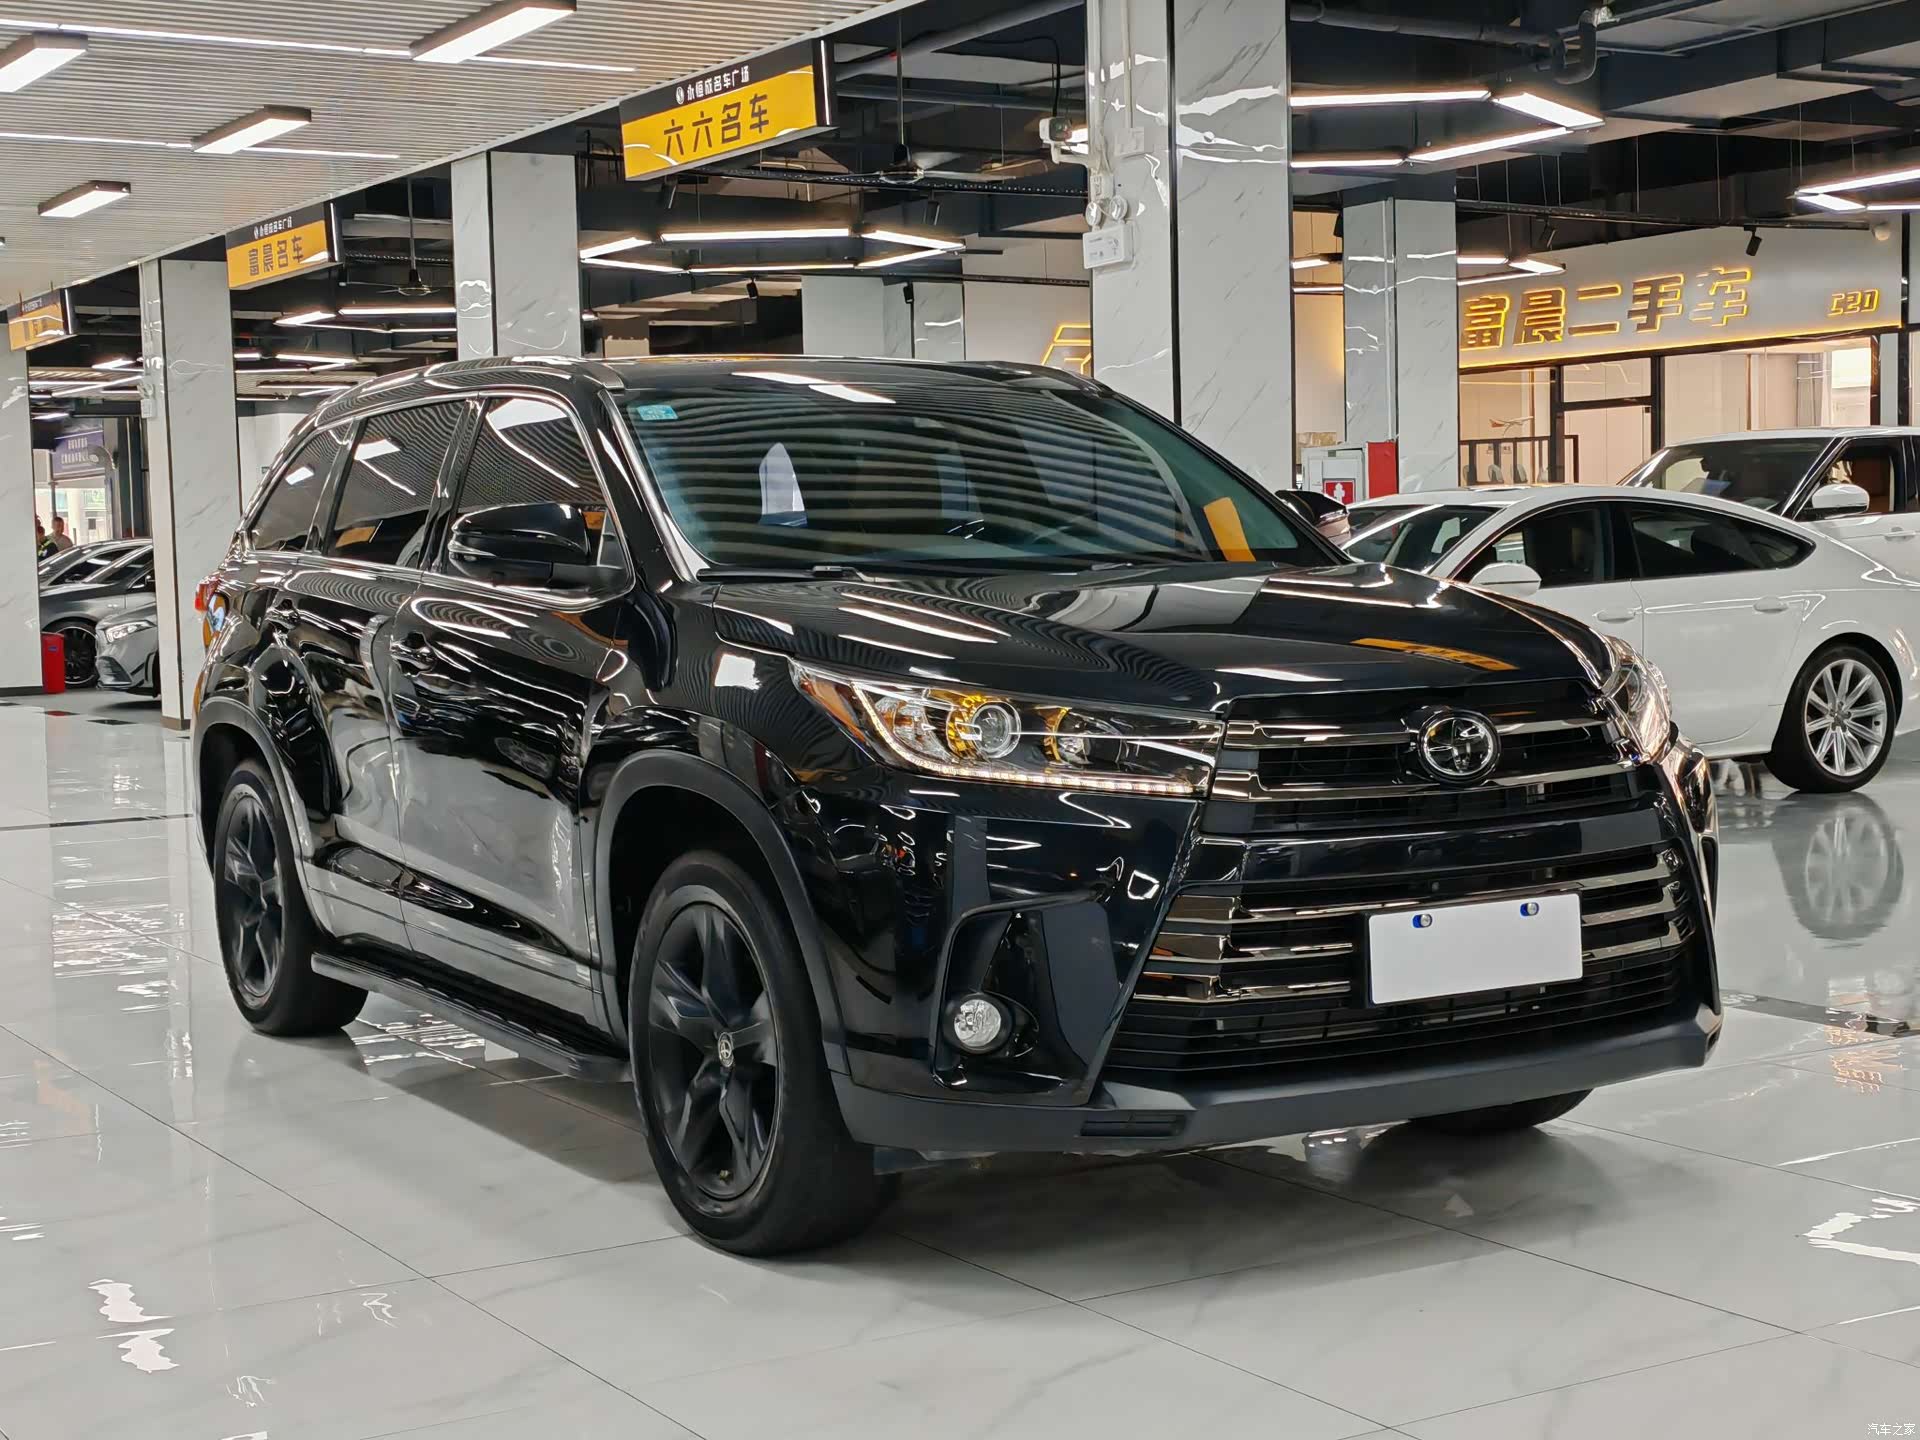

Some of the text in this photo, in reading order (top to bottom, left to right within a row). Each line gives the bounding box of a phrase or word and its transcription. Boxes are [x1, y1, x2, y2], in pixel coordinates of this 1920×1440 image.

[687, 65, 749, 101] 永恒成名车广场
[663, 93, 769, 156] 六六名车
[249, 235, 303, 276] 富晨名车
[1460, 266, 1752, 351] 富晨二手车
[1827, 288, 1879, 317] C20
